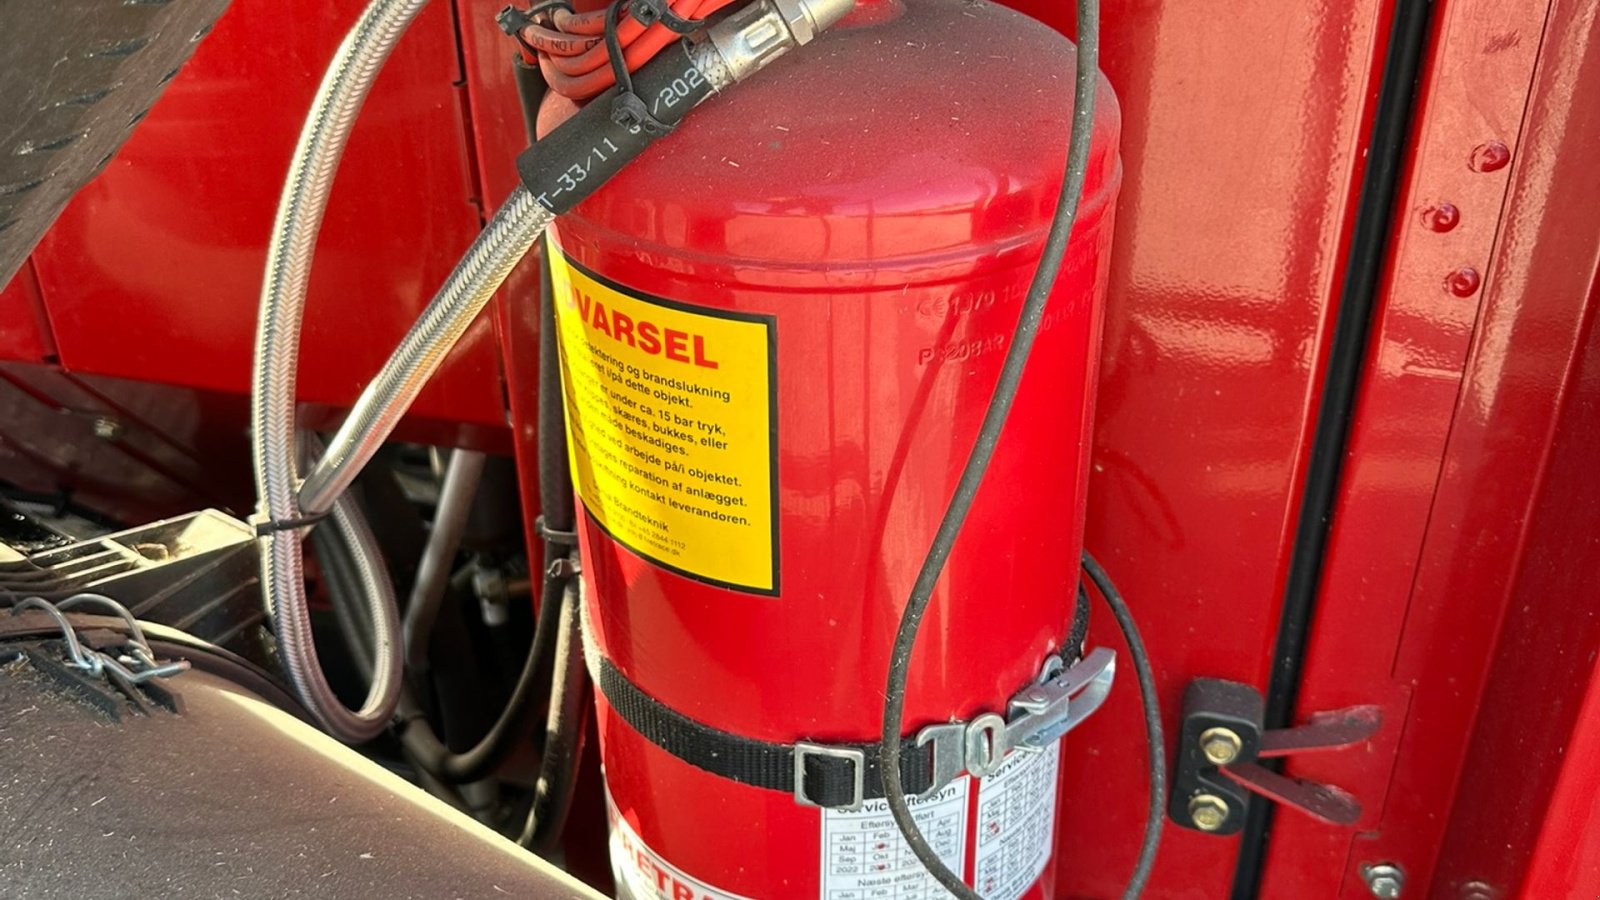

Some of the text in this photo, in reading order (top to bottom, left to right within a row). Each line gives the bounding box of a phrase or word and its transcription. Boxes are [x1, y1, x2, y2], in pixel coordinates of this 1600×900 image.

[551, 40, 574, 51] NOT
[625, 378, 651, 396] dette
[653, 388, 694, 409] objekt.
[627, 364, 640, 380] og
[643, 369, 731, 403] brandslukning
[610, 389, 637, 409] under
[640, 401, 655, 416] ca.
[658, 409, 671, 422] 15
[674, 415, 694, 428] bar
[697, 419, 726, 437] tryk,
[612, 405, 650, 430] skæres,
[653, 422, 698, 446] bukkes,
[700, 436, 729, 450] eller
[625, 424, 690, 456] beskadiges.
[619, 458, 669, 487] reparation
[671, 482, 683, 492] af
[686, 486, 748, 507] anlægget.
[624, 444, 661, 467] arbejde
[664, 458, 685, 474] på/i
[688, 467, 742, 487] objektet.
[629, 480, 666, 505] kontakt
[613, 497, 670, 533] Brandteknik
[860, 820, 897, 830] Eftersy
[873, 831, 890, 840] Feb
